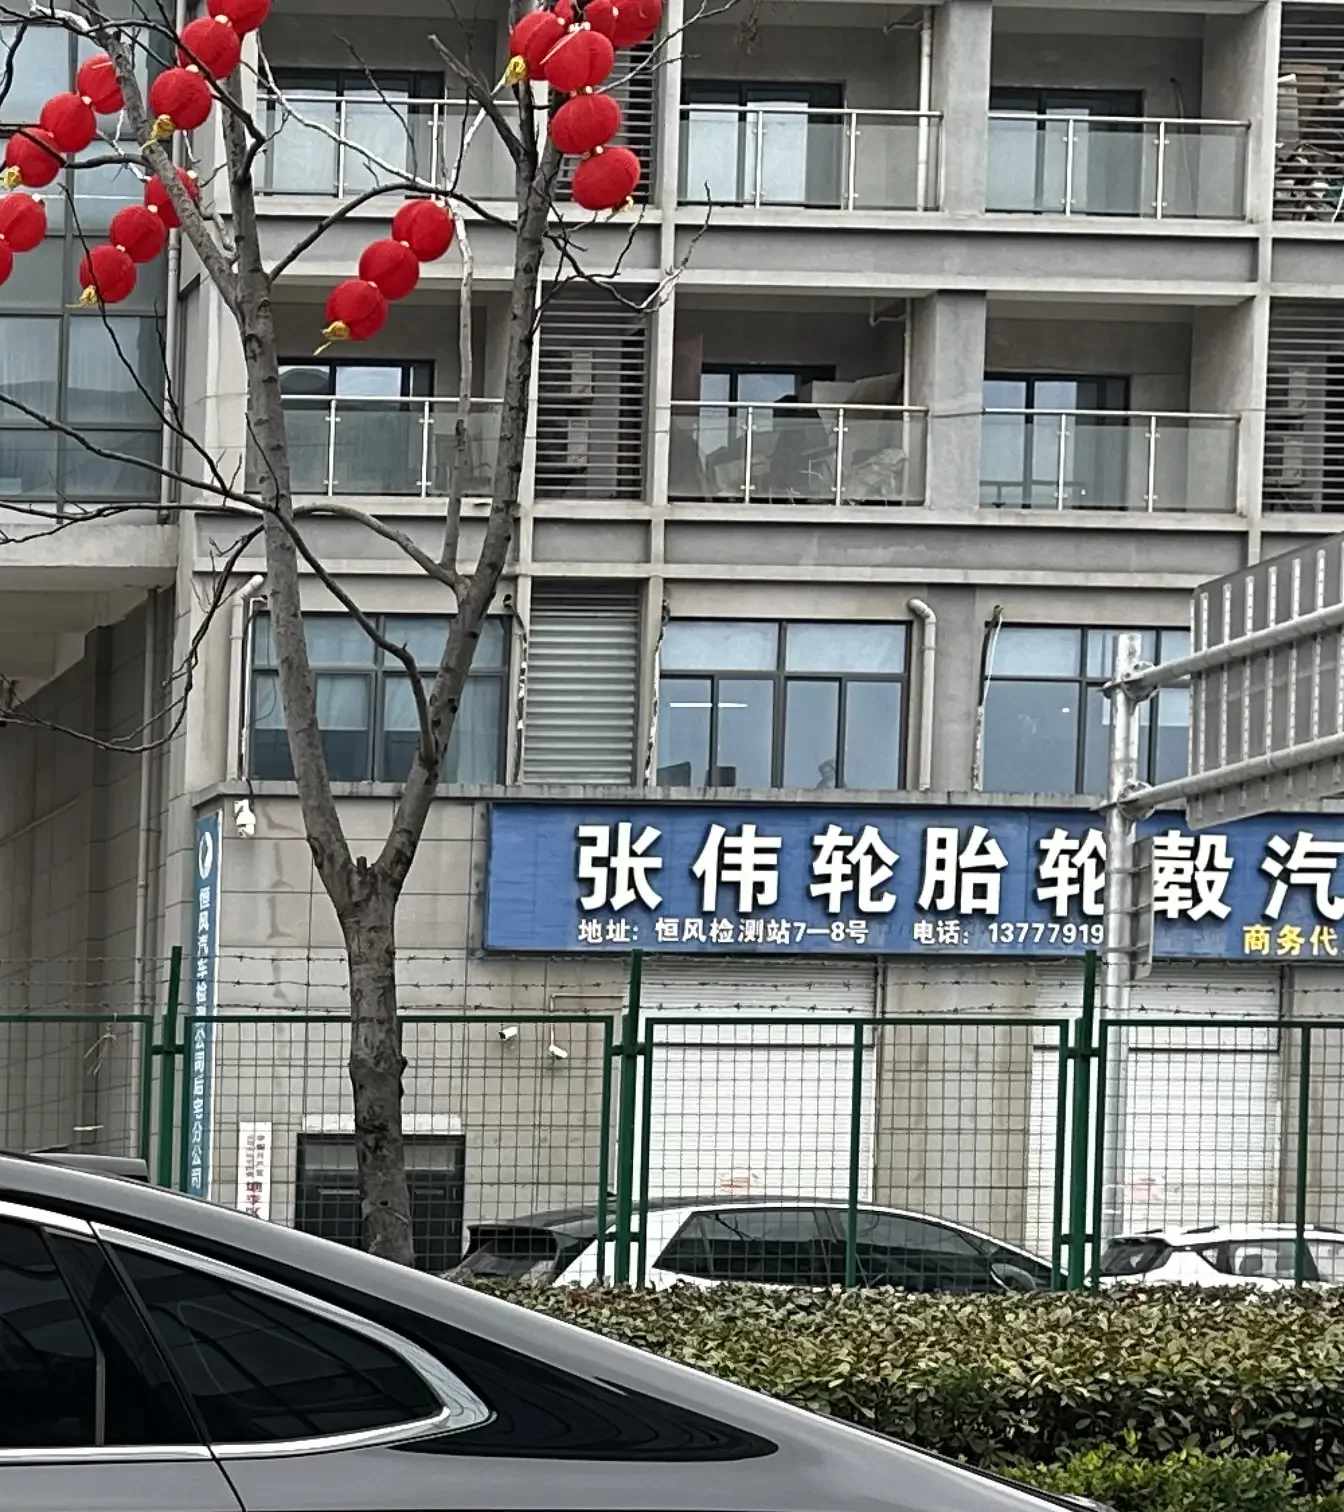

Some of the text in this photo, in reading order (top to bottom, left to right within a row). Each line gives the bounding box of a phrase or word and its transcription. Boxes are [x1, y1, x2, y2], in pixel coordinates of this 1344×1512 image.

[578, 822, 1344, 922] 张伟轮胎轮毂汽
[989, 922, 1105, 944] 13777919
[1243, 925, 1344, 956] 商务代
